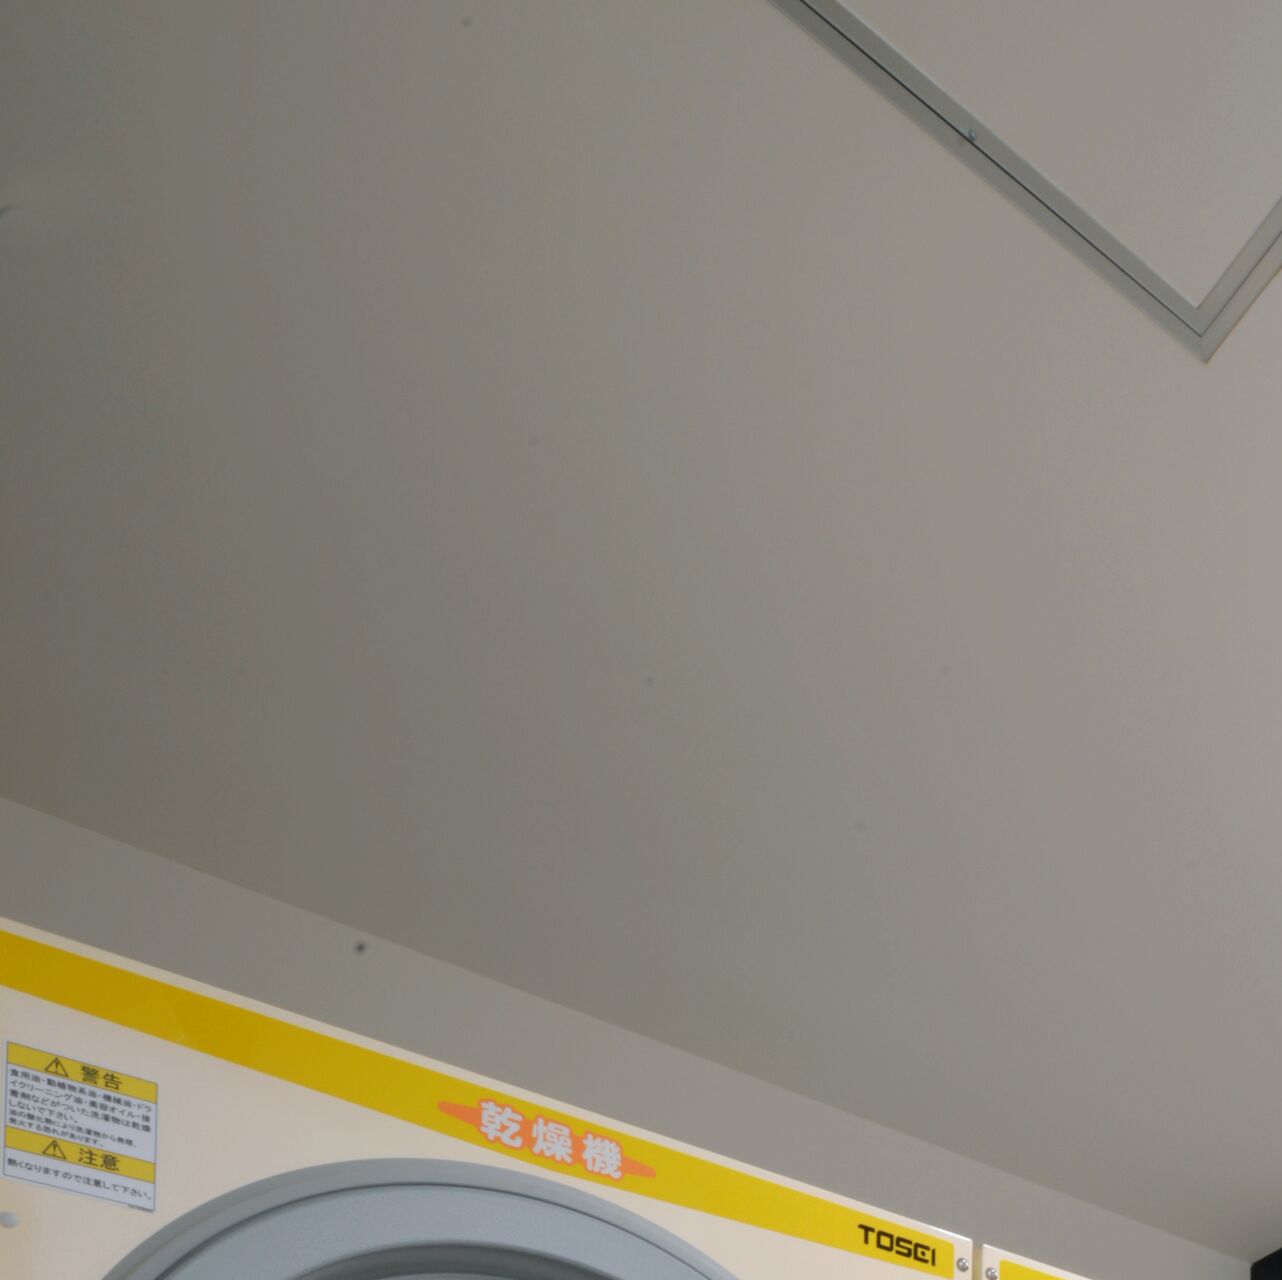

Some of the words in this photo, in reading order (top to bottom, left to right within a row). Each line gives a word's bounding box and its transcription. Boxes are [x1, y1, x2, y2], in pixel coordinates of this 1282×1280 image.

[81, 1066, 122, 1090] 警告
[479, 1099, 622, 1179] 乾燥機
[79, 1148, 120, 1171] 注意
[857, 1224, 936, 1267] TOSEI
